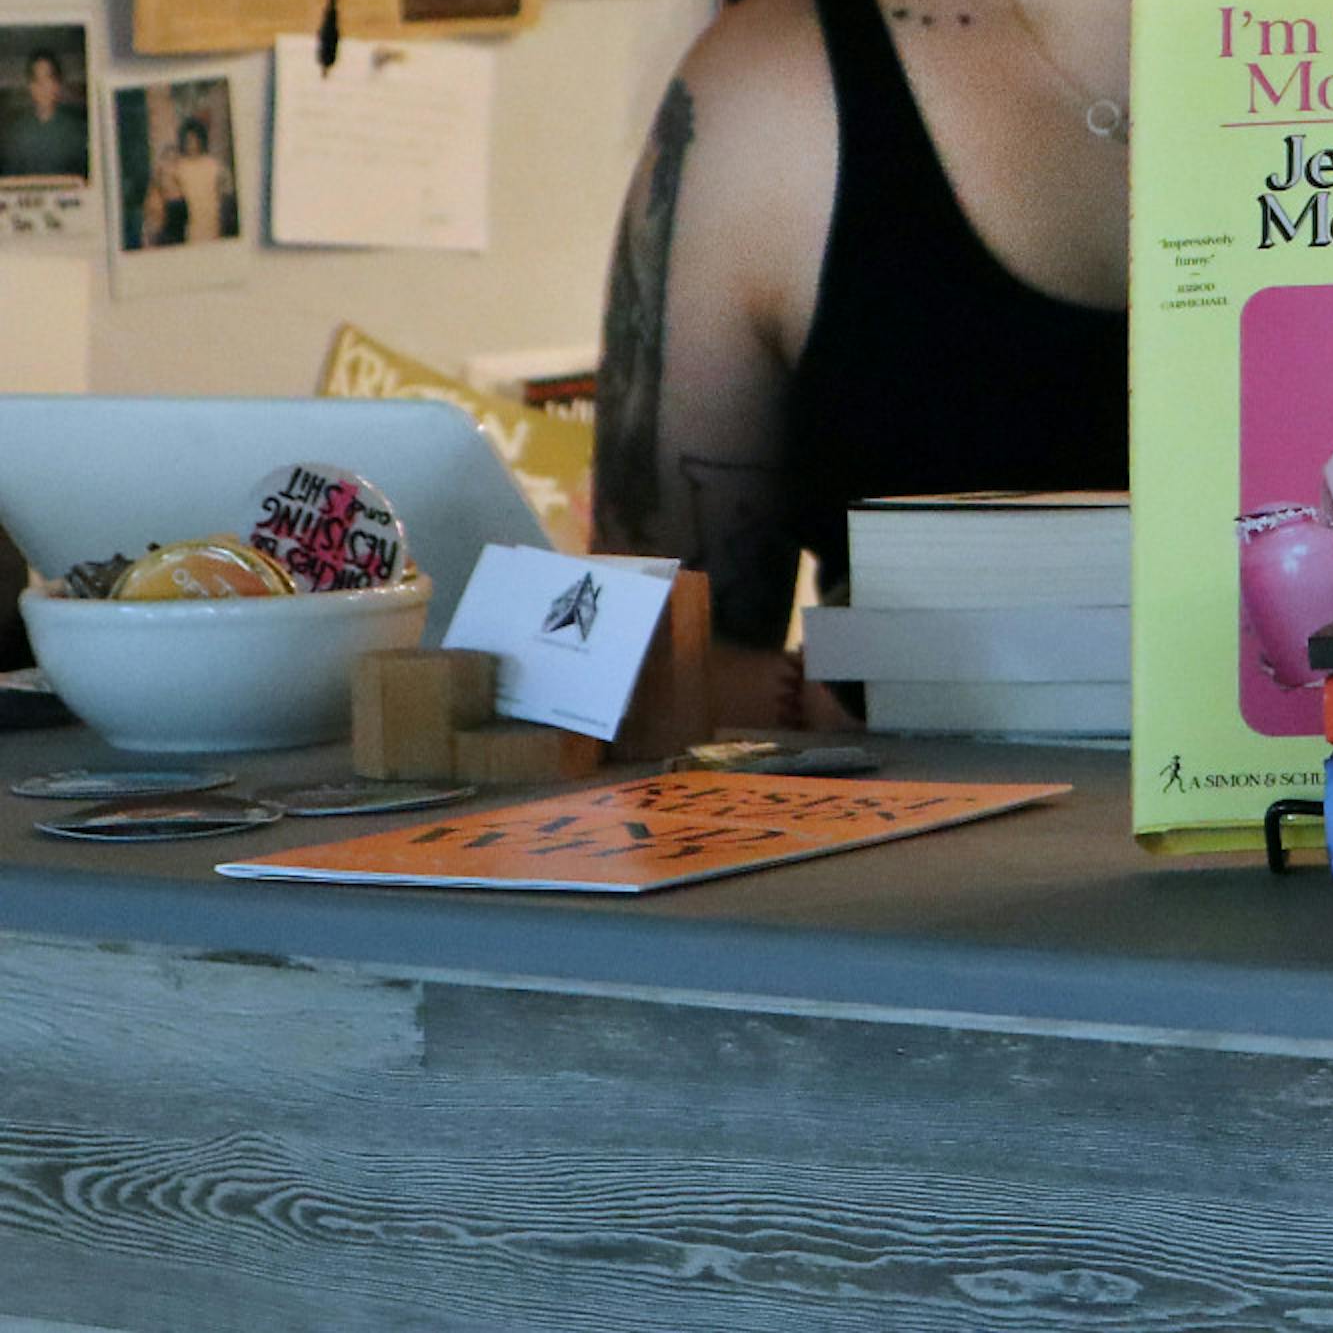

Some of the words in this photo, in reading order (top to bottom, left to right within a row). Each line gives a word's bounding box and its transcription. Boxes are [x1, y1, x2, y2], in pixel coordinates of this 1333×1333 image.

[1218, 6, 1319, 59] I'm
[345, 498, 391, 526] and
[1190, 775, 1201, 790] A
[1203, 771, 1262, 789] SIMON
[1263, 773, 1277, 787] &
